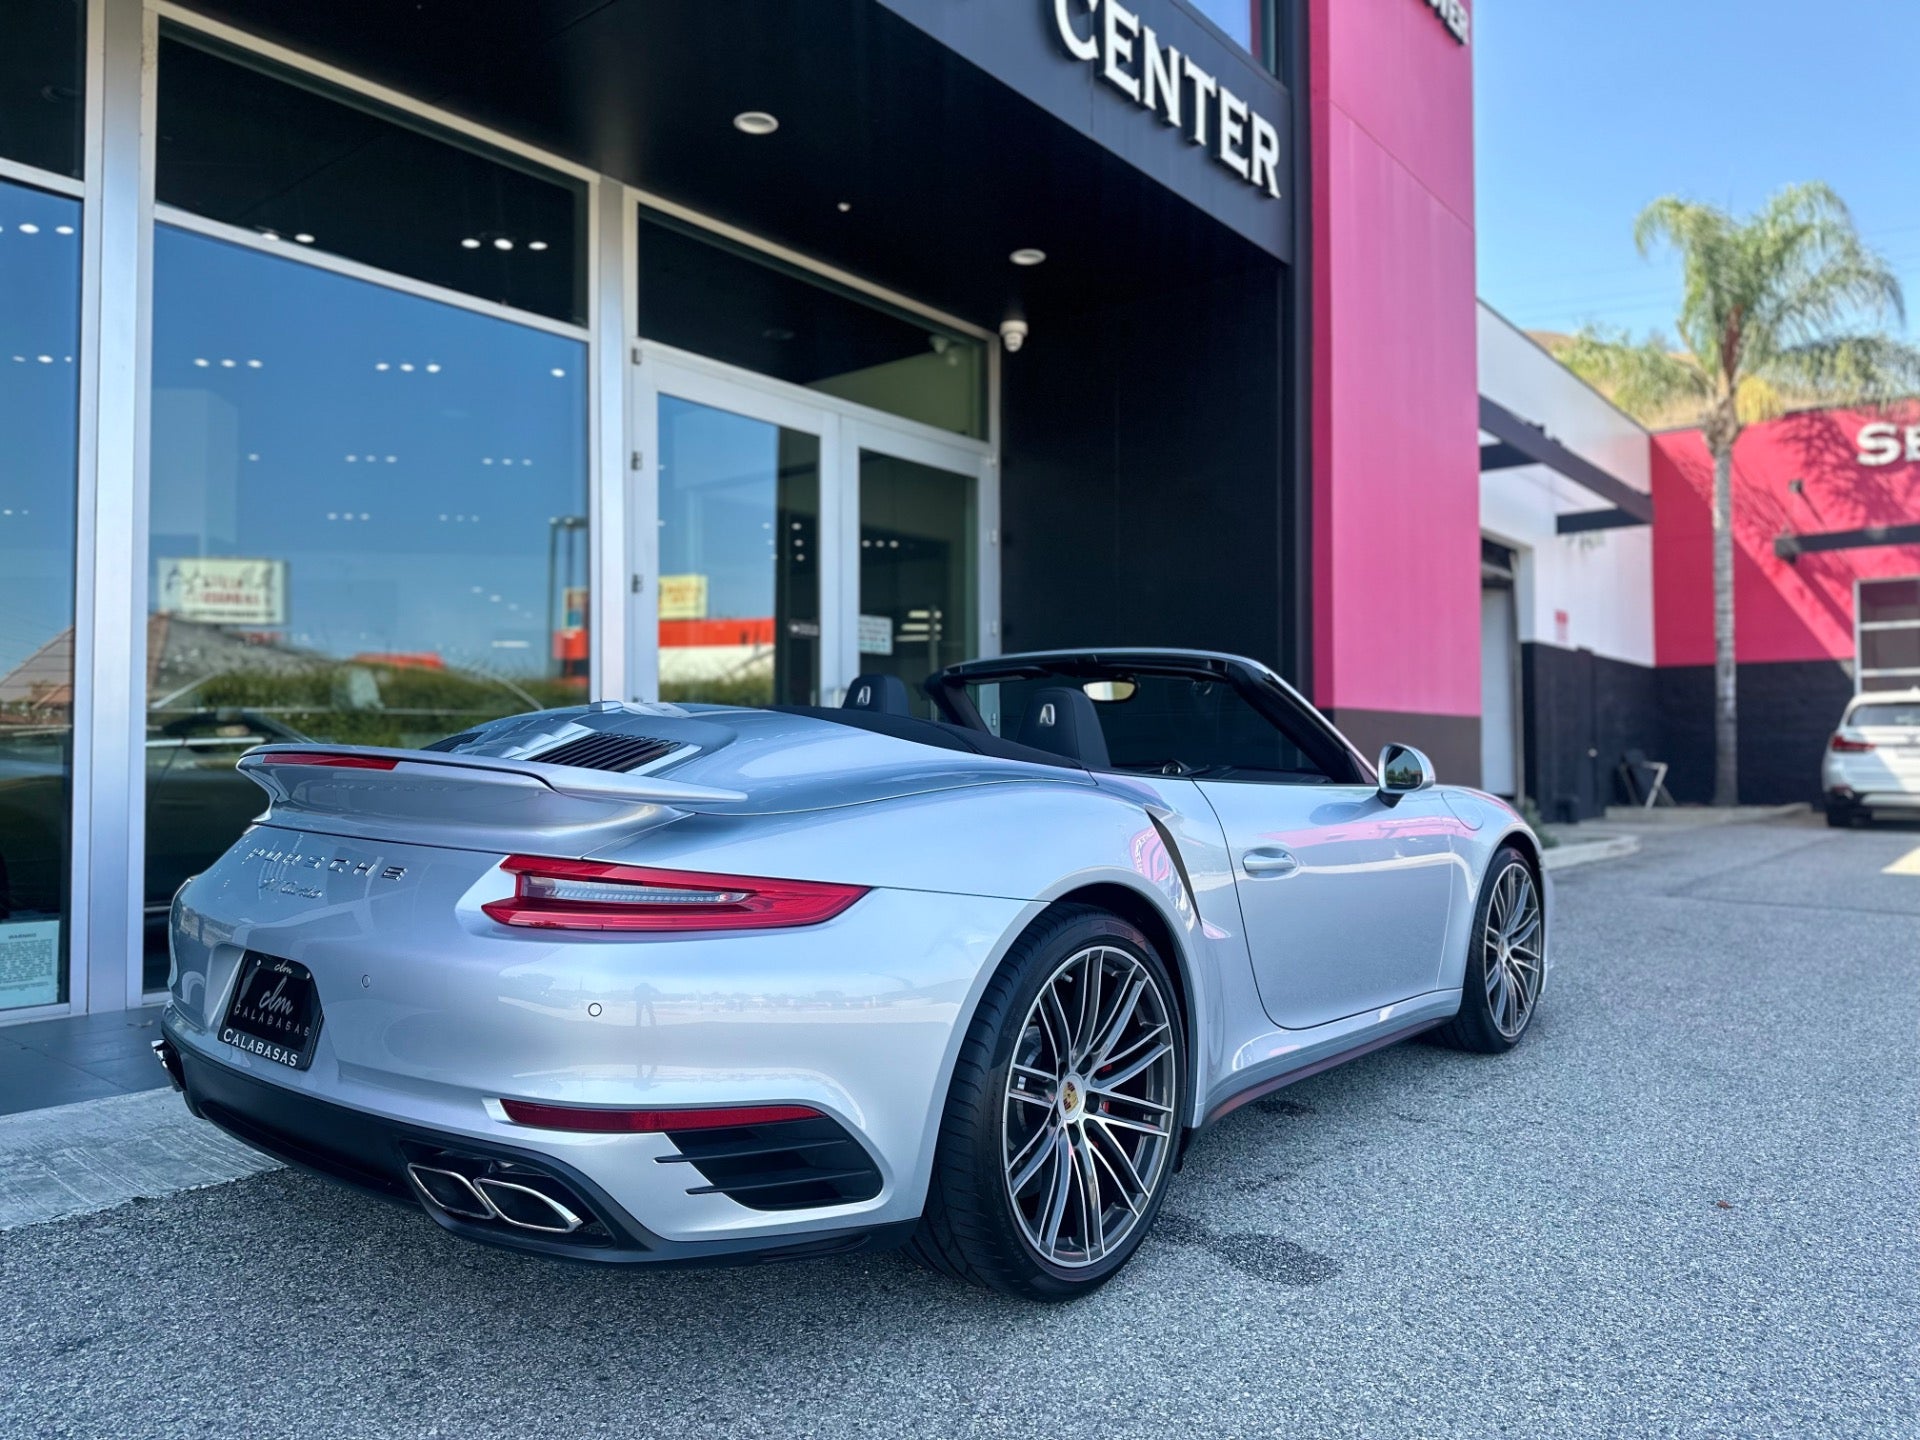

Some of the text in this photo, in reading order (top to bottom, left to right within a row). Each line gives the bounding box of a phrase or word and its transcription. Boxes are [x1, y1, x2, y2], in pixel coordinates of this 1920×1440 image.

[1055, 0, 1281, 199] CENTER
[242, 847, 408, 882] PORSCHE
[233, 1004, 311, 1037] CALABASAS
[223, 1028, 299, 1067] CALABASAS
